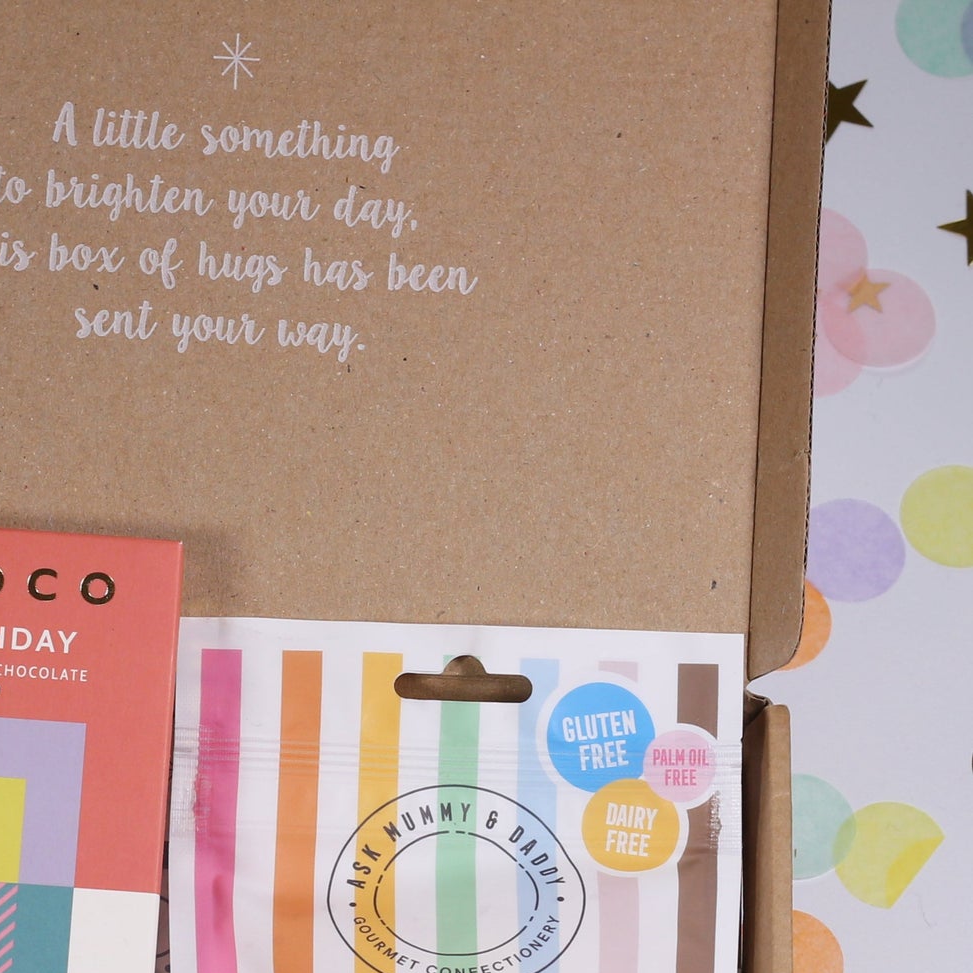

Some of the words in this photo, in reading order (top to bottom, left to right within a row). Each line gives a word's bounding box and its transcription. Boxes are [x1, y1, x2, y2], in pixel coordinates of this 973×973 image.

[52, 101, 77, 146] A
[93, 109, 185, 150] little
[202, 120, 399, 173] something
[45, 169, 214, 221] brighten
[227, 187, 321, 229] your
[333, 185, 418, 238] day,
[49, 233, 124, 273] box
[139, 238, 183, 289] of
[199, 241, 288, 292] hugs
[304, 248, 373, 291] has
[388, 253, 478, 295] been
[74, 301, 158, 340] sent
[171, 313, 265, 353] your
[277, 318, 366, 362] way.
[562, 709, 637, 743] GLUTEN
[579, 739, 629, 771] FREE
[653, 748, 684, 766] PALM
[688, 749, 709, 766] OIL
[664, 769, 697, 786] FREE
[605, 802, 659, 831] DAIRY
[346, 843, 382, 889] ASK
[383, 802, 470, 842] MUMMY
[485, 810, 499, 830] &
[508, 825, 566, 886] DADDY
[605, 829, 651, 857] FREE
[353, 916, 420, 970] GOURMET
